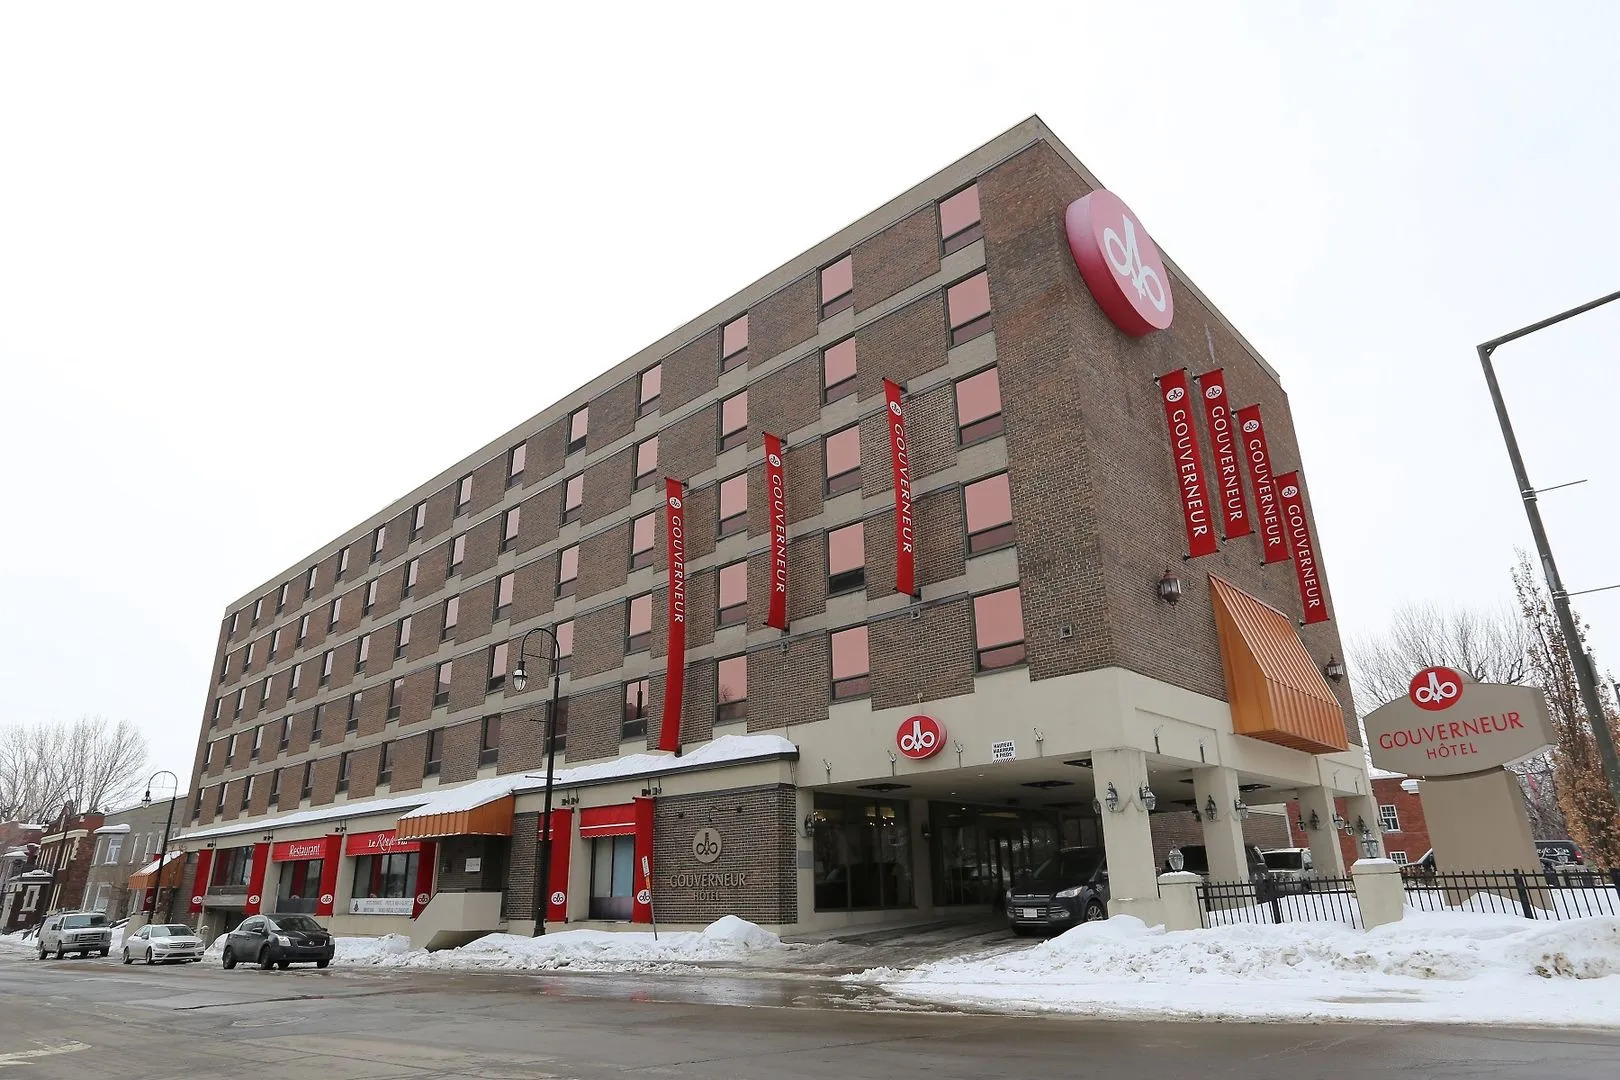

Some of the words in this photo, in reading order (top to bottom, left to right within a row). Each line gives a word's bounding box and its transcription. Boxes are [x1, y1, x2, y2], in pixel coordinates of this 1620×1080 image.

[894, 423, 912, 553] GOUVERNEUR
[1173, 409, 1208, 538] GOUVERNEUR
[1212, 406, 1243, 522] GOUVERNEUR
[1250, 439, 1281, 547] GOUVERNEUR
[672, 515, 684, 623] GOUVERNEUR
[772, 474, 786, 593] GOUVERNEUR
[1288, 504, 1320, 609] GOUVERNEUR
[1379, 711, 1524, 750] GOUVERNEUR
[1426, 742, 1478, 760] HÔTEL
[290, 844, 320, 856] Restaurant
[670, 873, 746, 888] GOUVERNEUR
[693, 889, 721, 901] HÔTEL
